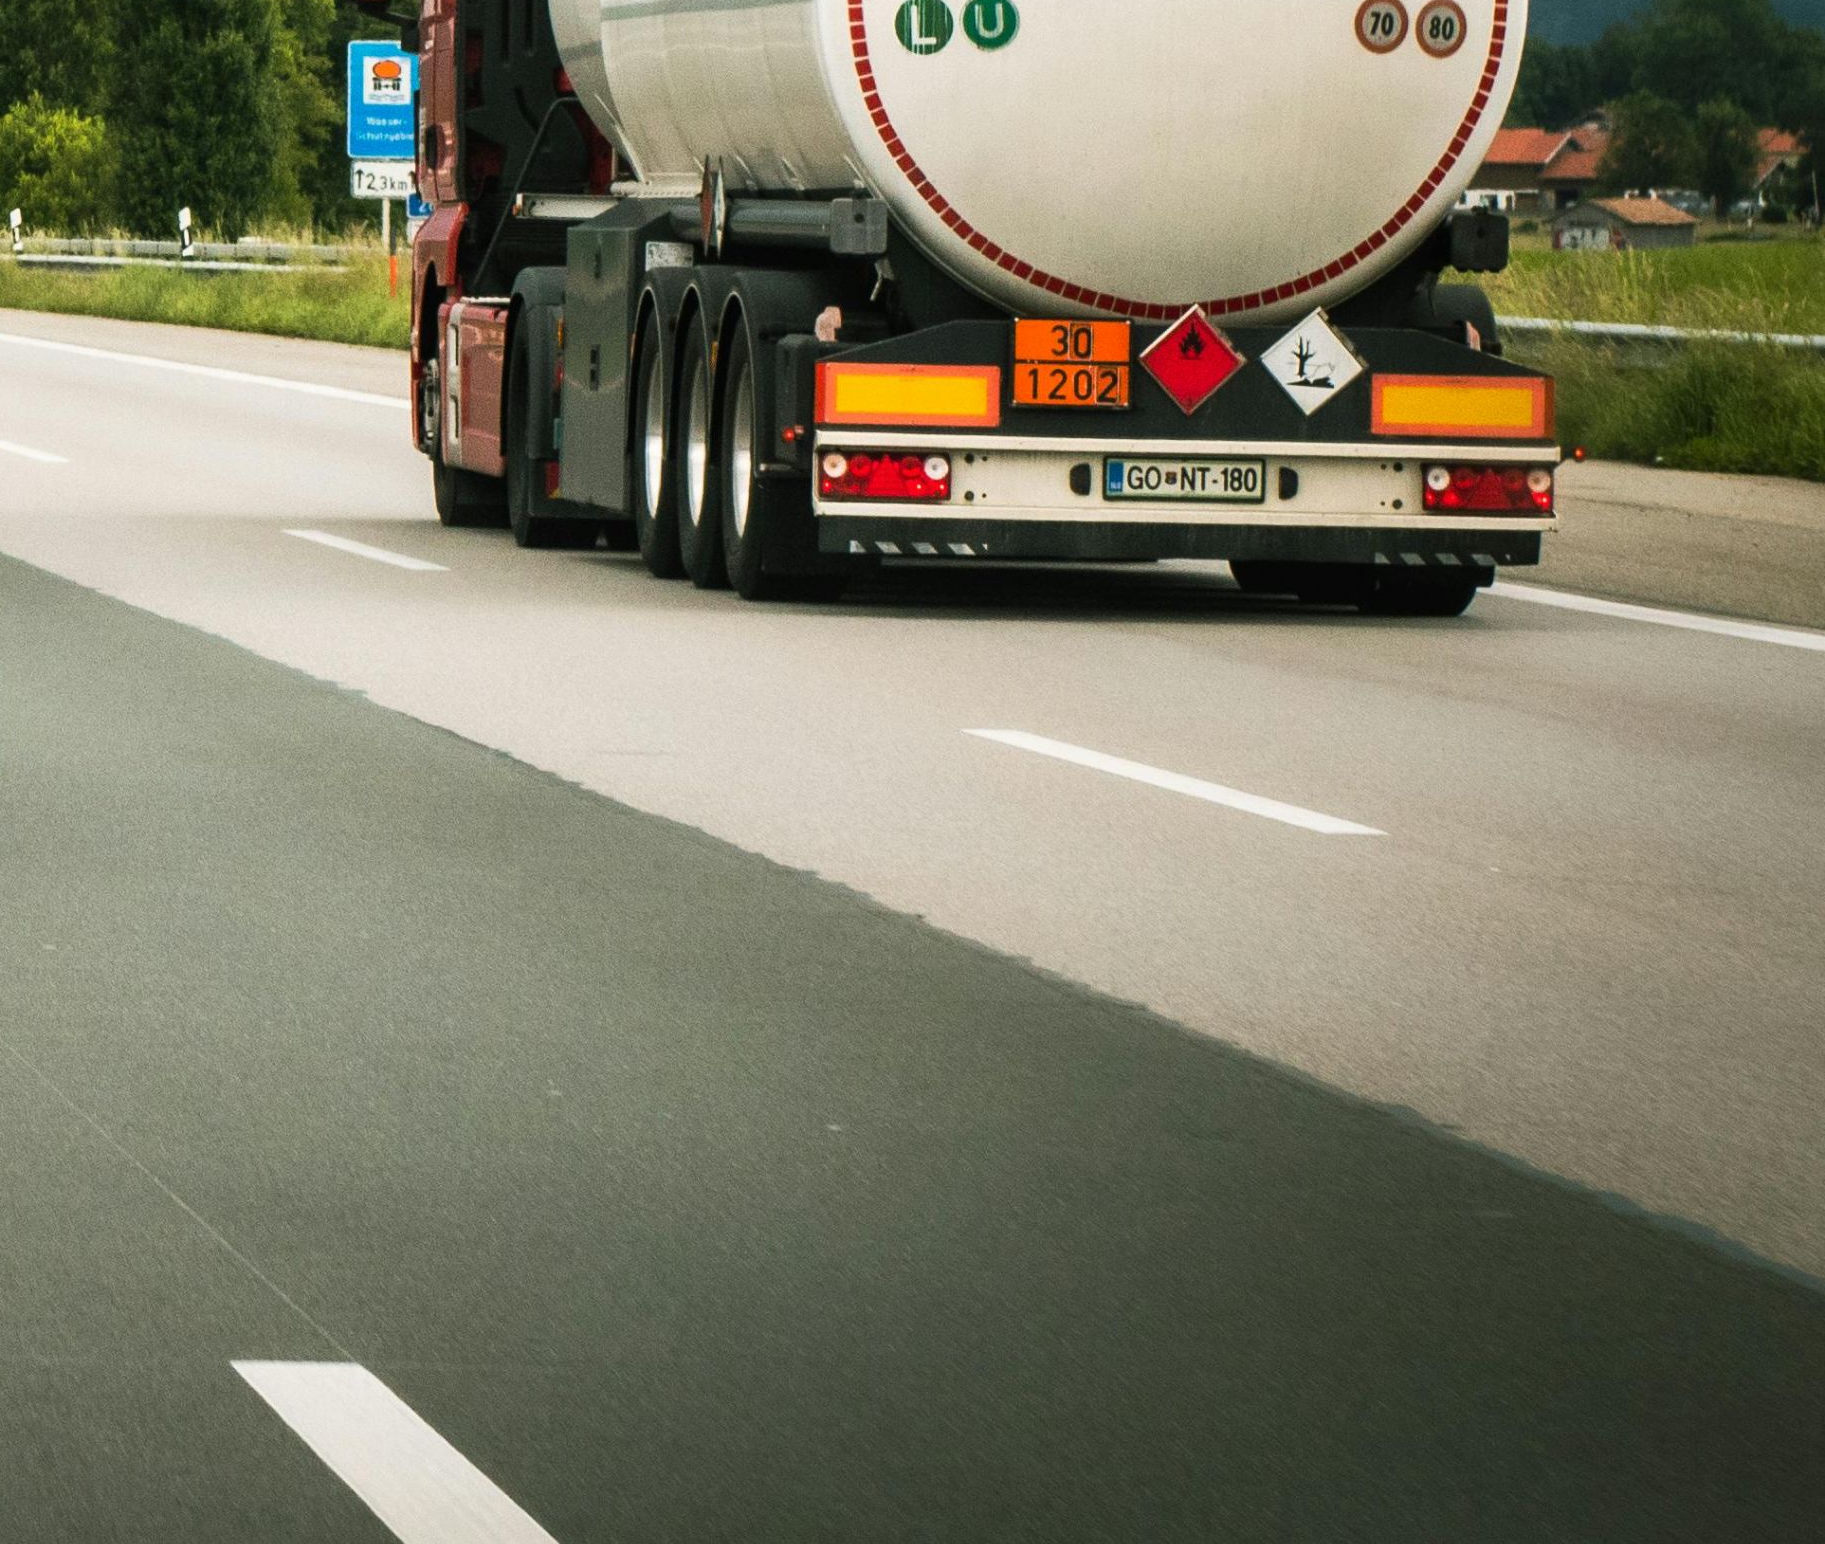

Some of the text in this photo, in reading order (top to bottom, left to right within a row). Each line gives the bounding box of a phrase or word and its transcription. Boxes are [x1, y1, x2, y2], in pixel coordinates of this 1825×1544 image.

[909, 4, 937, 47] L
[974, 2, 1006, 39] U
[1369, 11, 1395, 37] 70
[1428, 15, 1456, 41] 80
[1051, 324, 1092, 357] 30
[1027, 369, 1118, 405] 1202
[1127, 465, 1257, 492] GO NT-180
